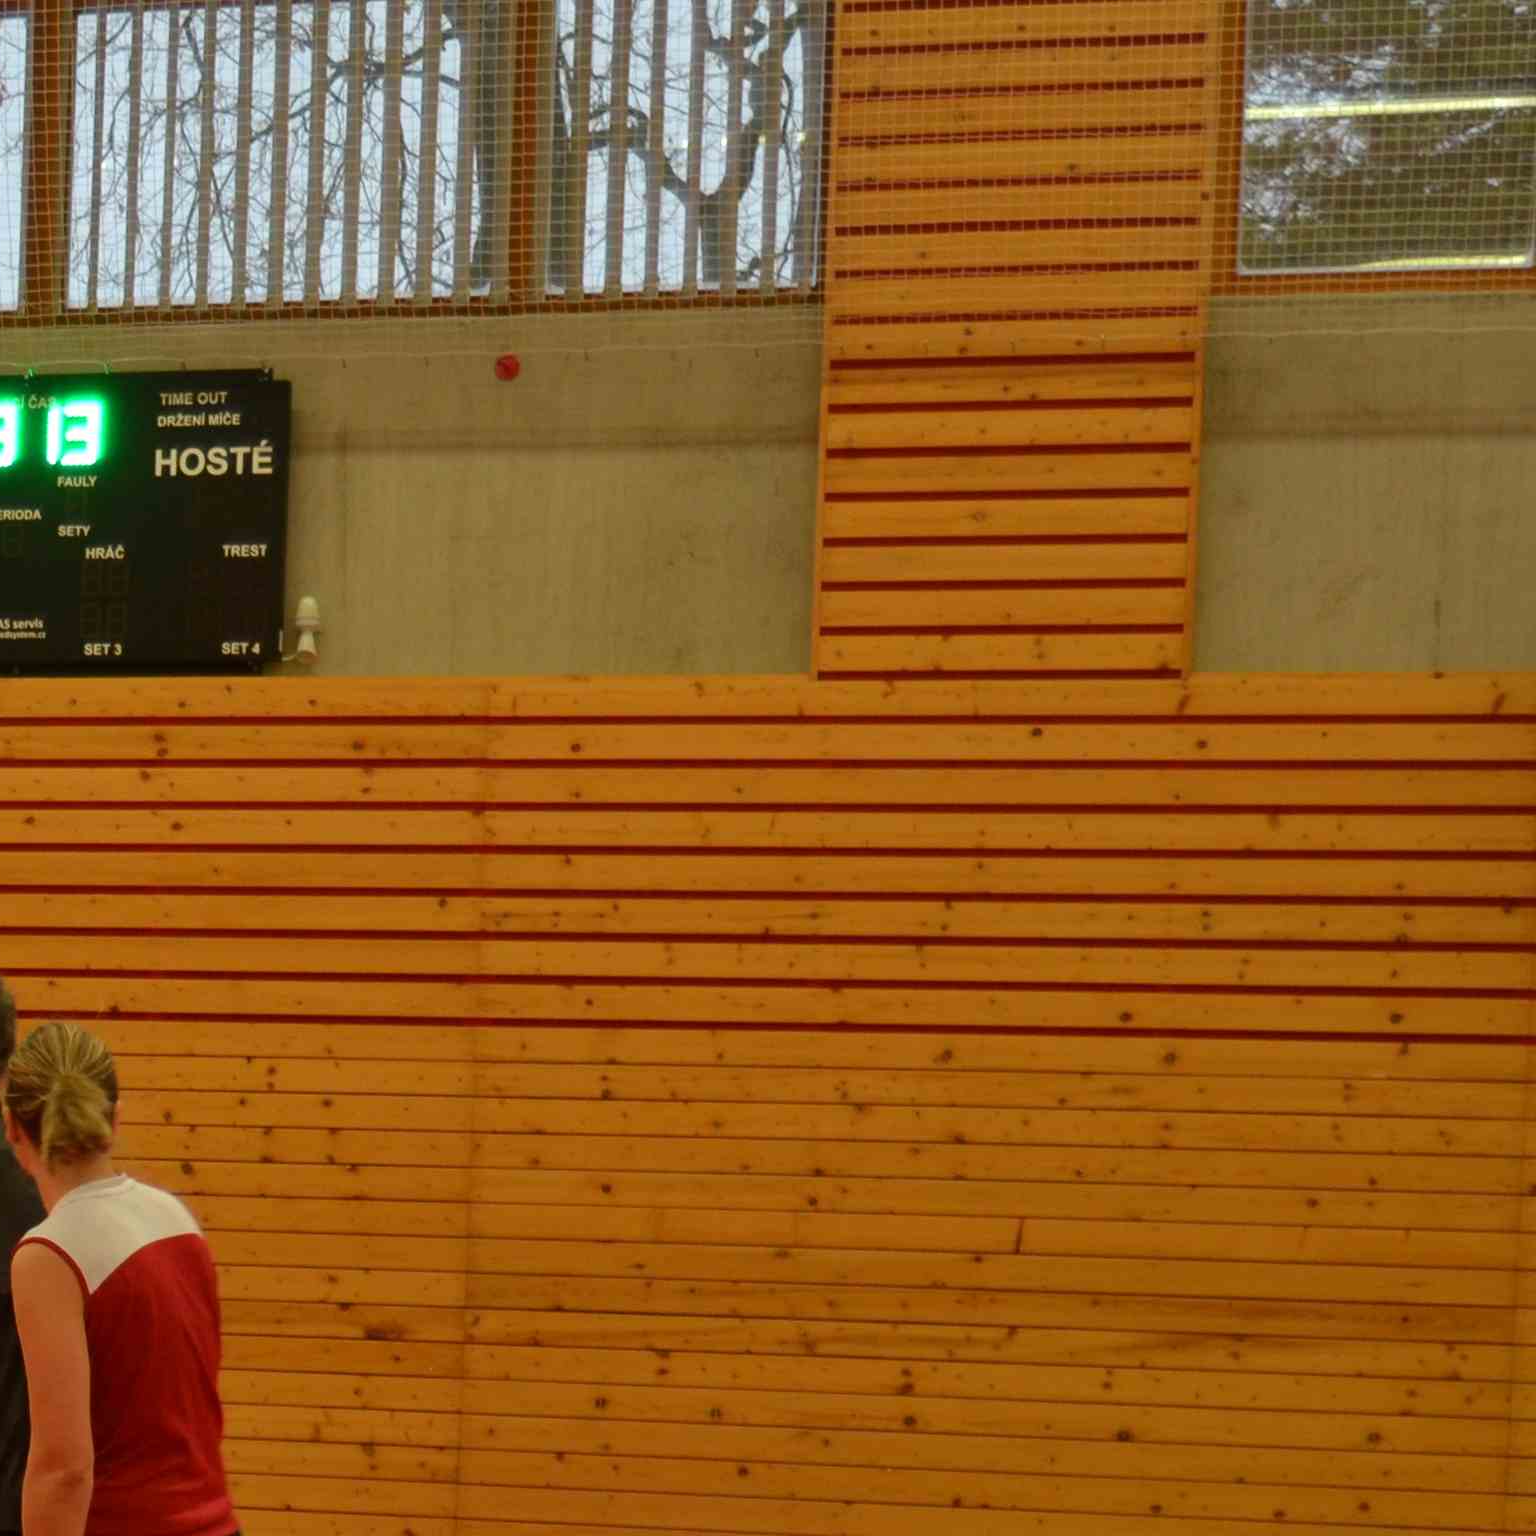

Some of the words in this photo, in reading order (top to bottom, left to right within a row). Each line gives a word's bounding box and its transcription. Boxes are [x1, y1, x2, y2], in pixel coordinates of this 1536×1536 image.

[159, 392, 194, 406] TIME
[196, 391, 228, 405] OUT
[157, 411, 206, 428] DRŽENÍ
[207, 410, 241, 426] MÍČE
[45, 398, 104, 466] 13
[154, 439, 273, 477] HOSTÉ
[57, 474, 98, 489] FAULY
[57, 524, 91, 538] SETY
[85, 543, 125, 560] HRÁČ
[222, 543, 268, 558] TREST
[12, 617, 45, 630] servis
[83, 642, 111, 657] SET
[113, 642, 123, 657] 3
[221, 641, 250, 656] SET
[251, 641, 262, 656] 4
